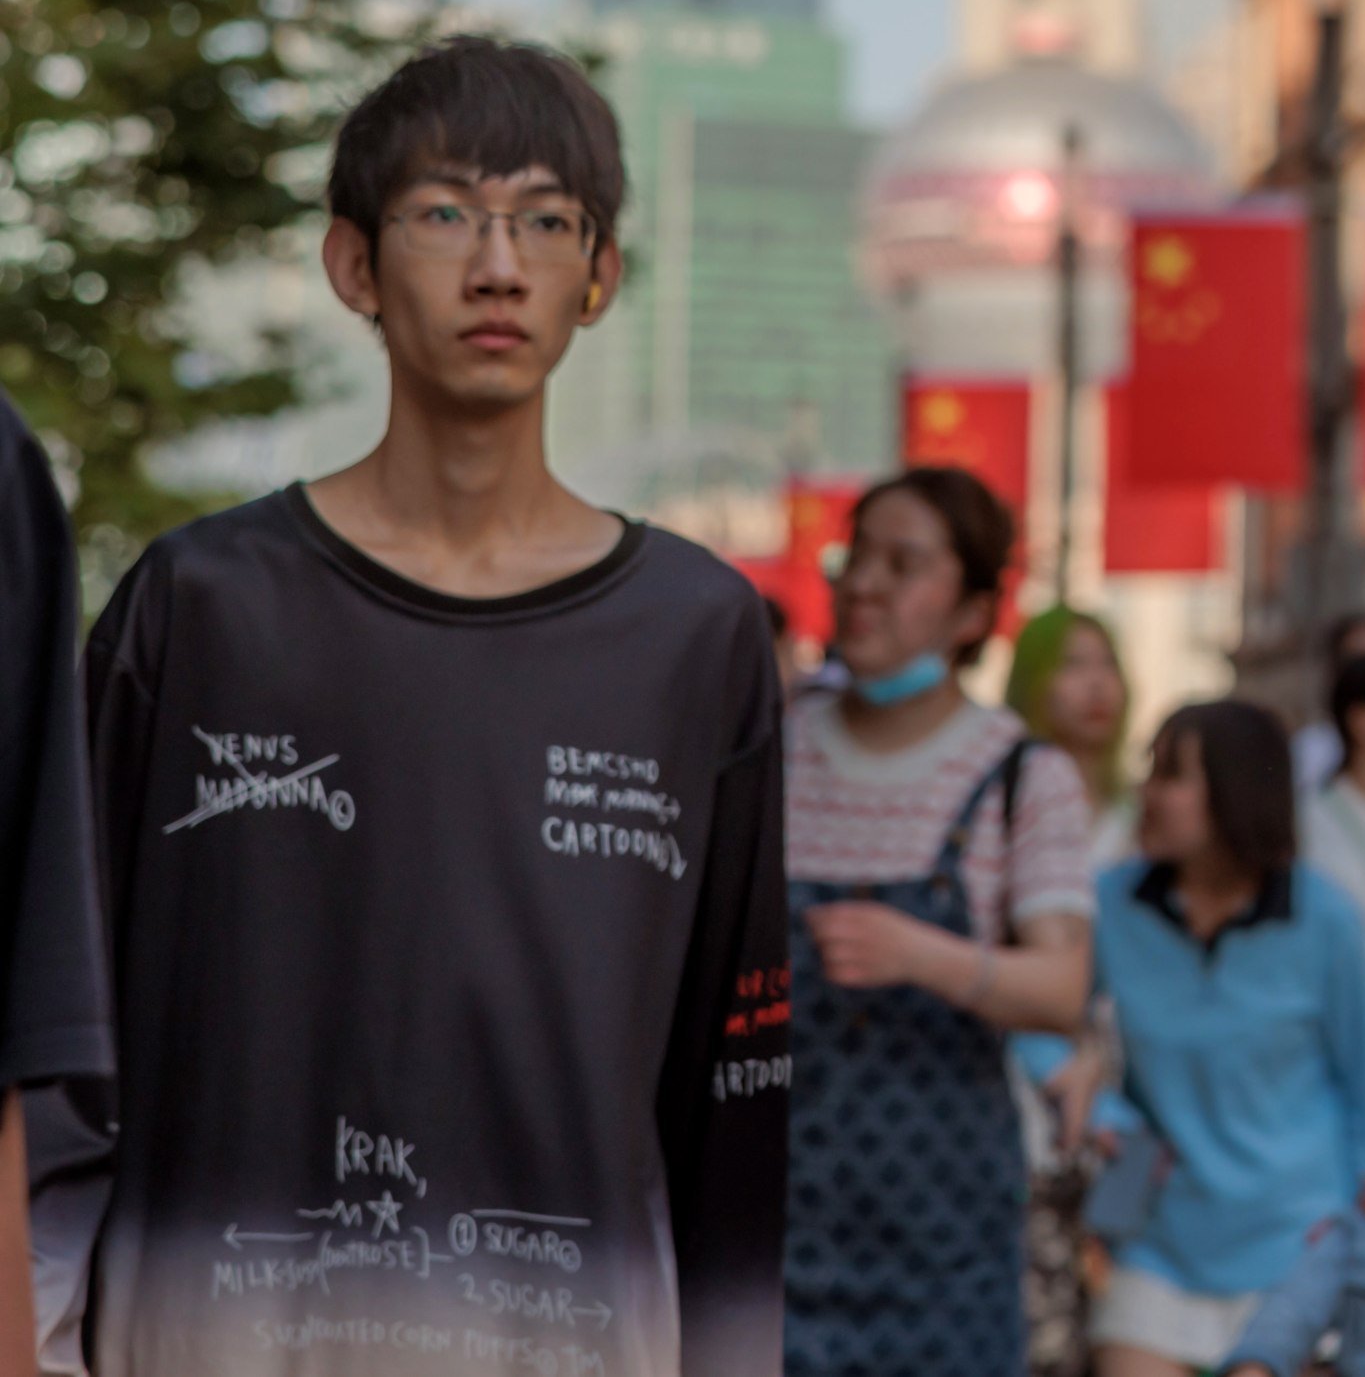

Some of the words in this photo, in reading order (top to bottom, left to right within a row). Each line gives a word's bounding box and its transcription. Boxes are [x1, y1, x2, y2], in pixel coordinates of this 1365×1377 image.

[208, 733, 299, 766] VENUS
[457, 1272, 485, 1305] 2
[488, 1278, 576, 1327] SUGAR
